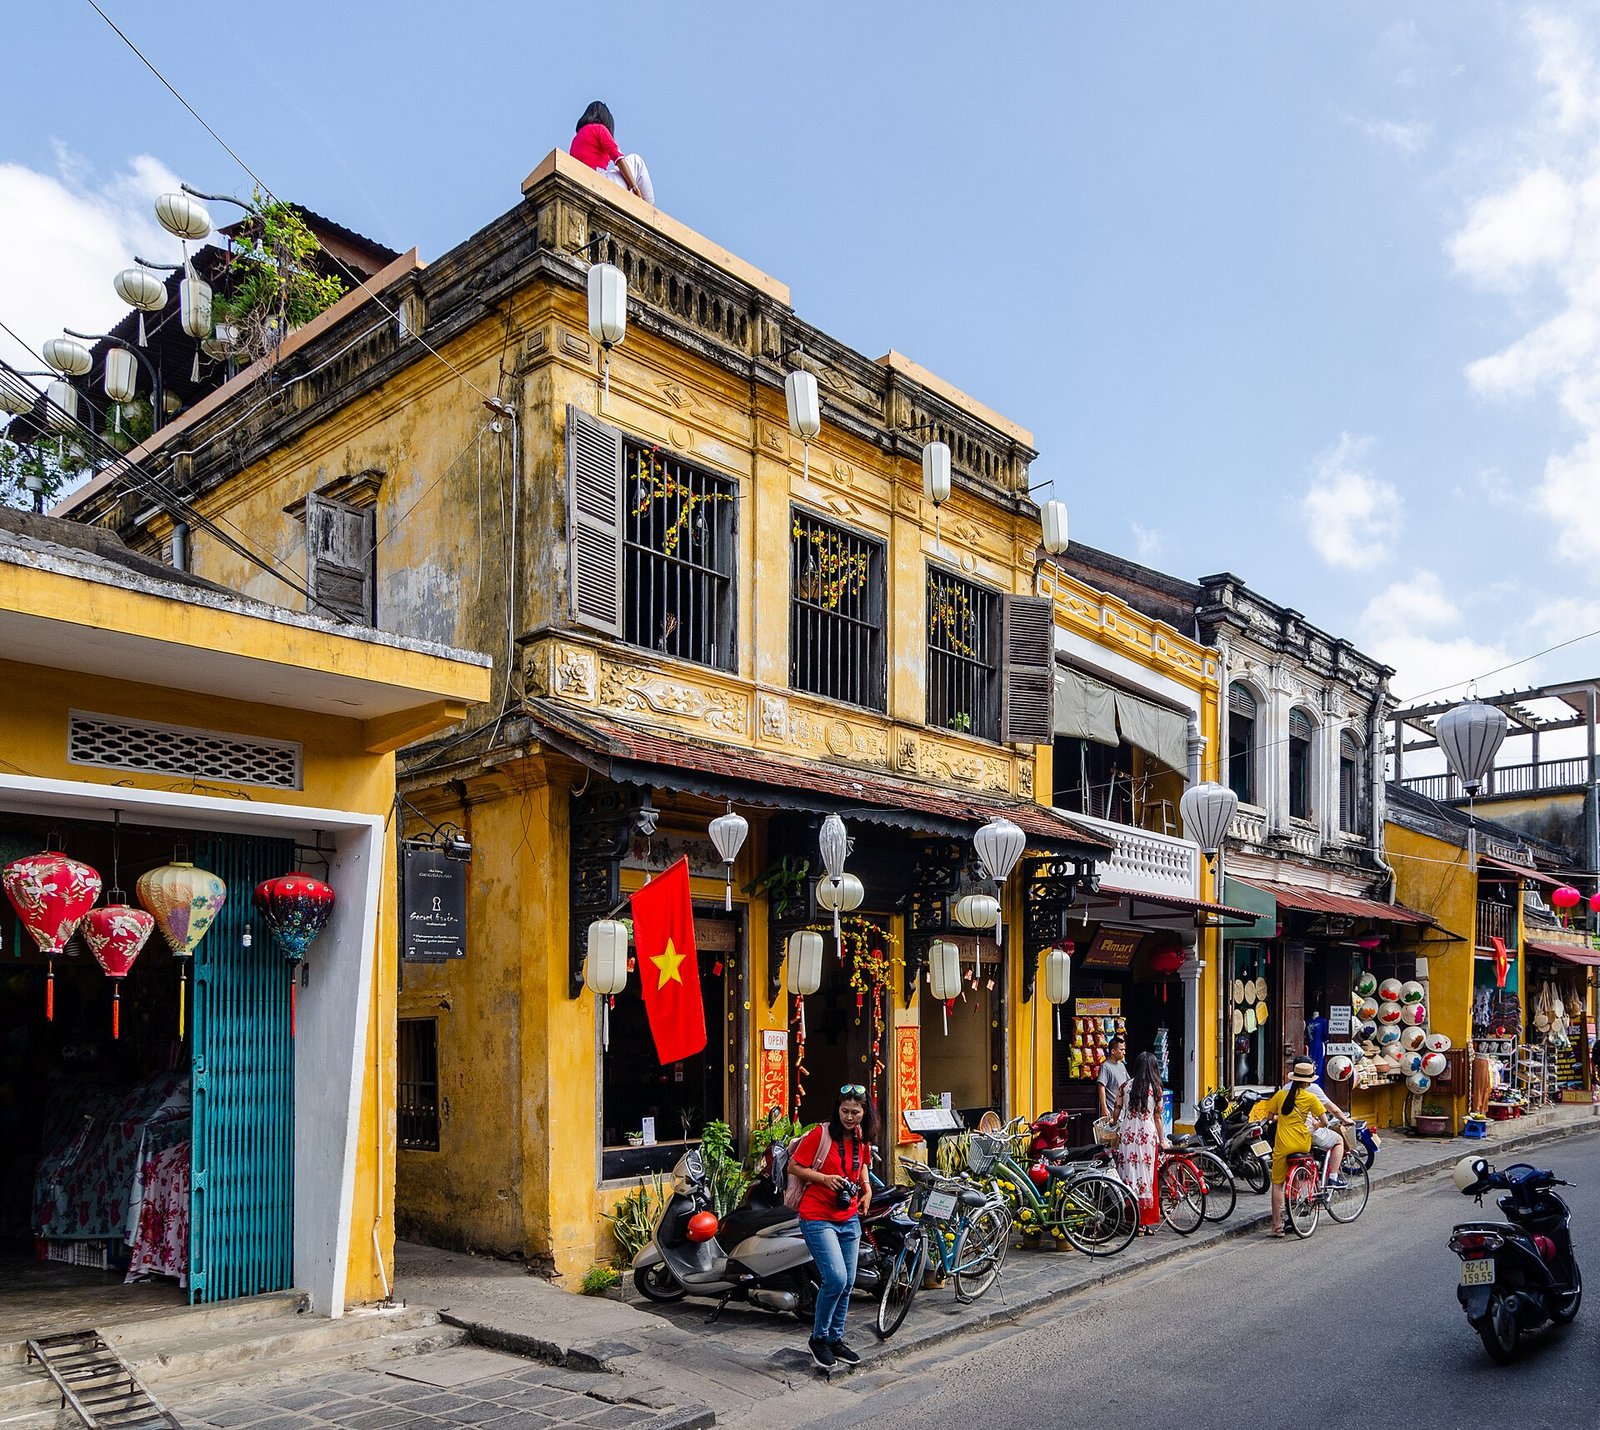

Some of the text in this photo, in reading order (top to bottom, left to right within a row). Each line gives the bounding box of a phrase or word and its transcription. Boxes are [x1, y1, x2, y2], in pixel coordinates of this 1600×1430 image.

[768, 1035, 784, 1045] OPEN
[1465, 1260, 1488, 1272] 92-C1
[1463, 1271, 1493, 1284] 159.55
